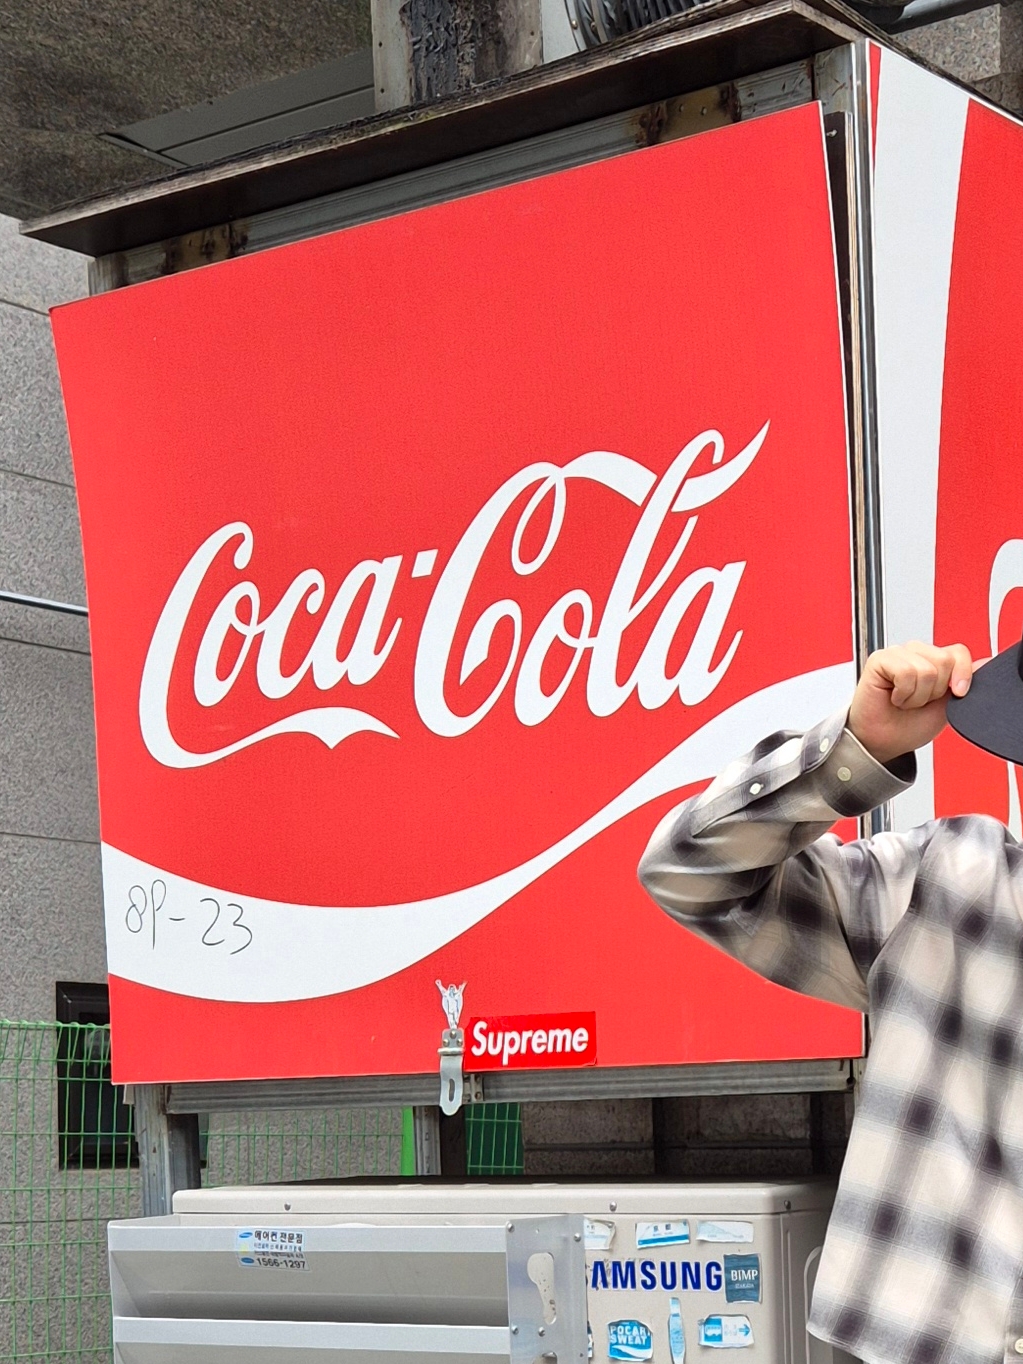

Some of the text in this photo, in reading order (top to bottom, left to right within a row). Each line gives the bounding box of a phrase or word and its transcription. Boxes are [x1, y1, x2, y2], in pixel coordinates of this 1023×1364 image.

[139, 419, 770, 768] Coca-Cola
[471, 1021, 589, 1059] Supreme
[590, 1260, 722, 1290] AMSUNG
[730, 1269, 759, 1281] BIMP
[610, 1334, 647, 1345] SWEAT
